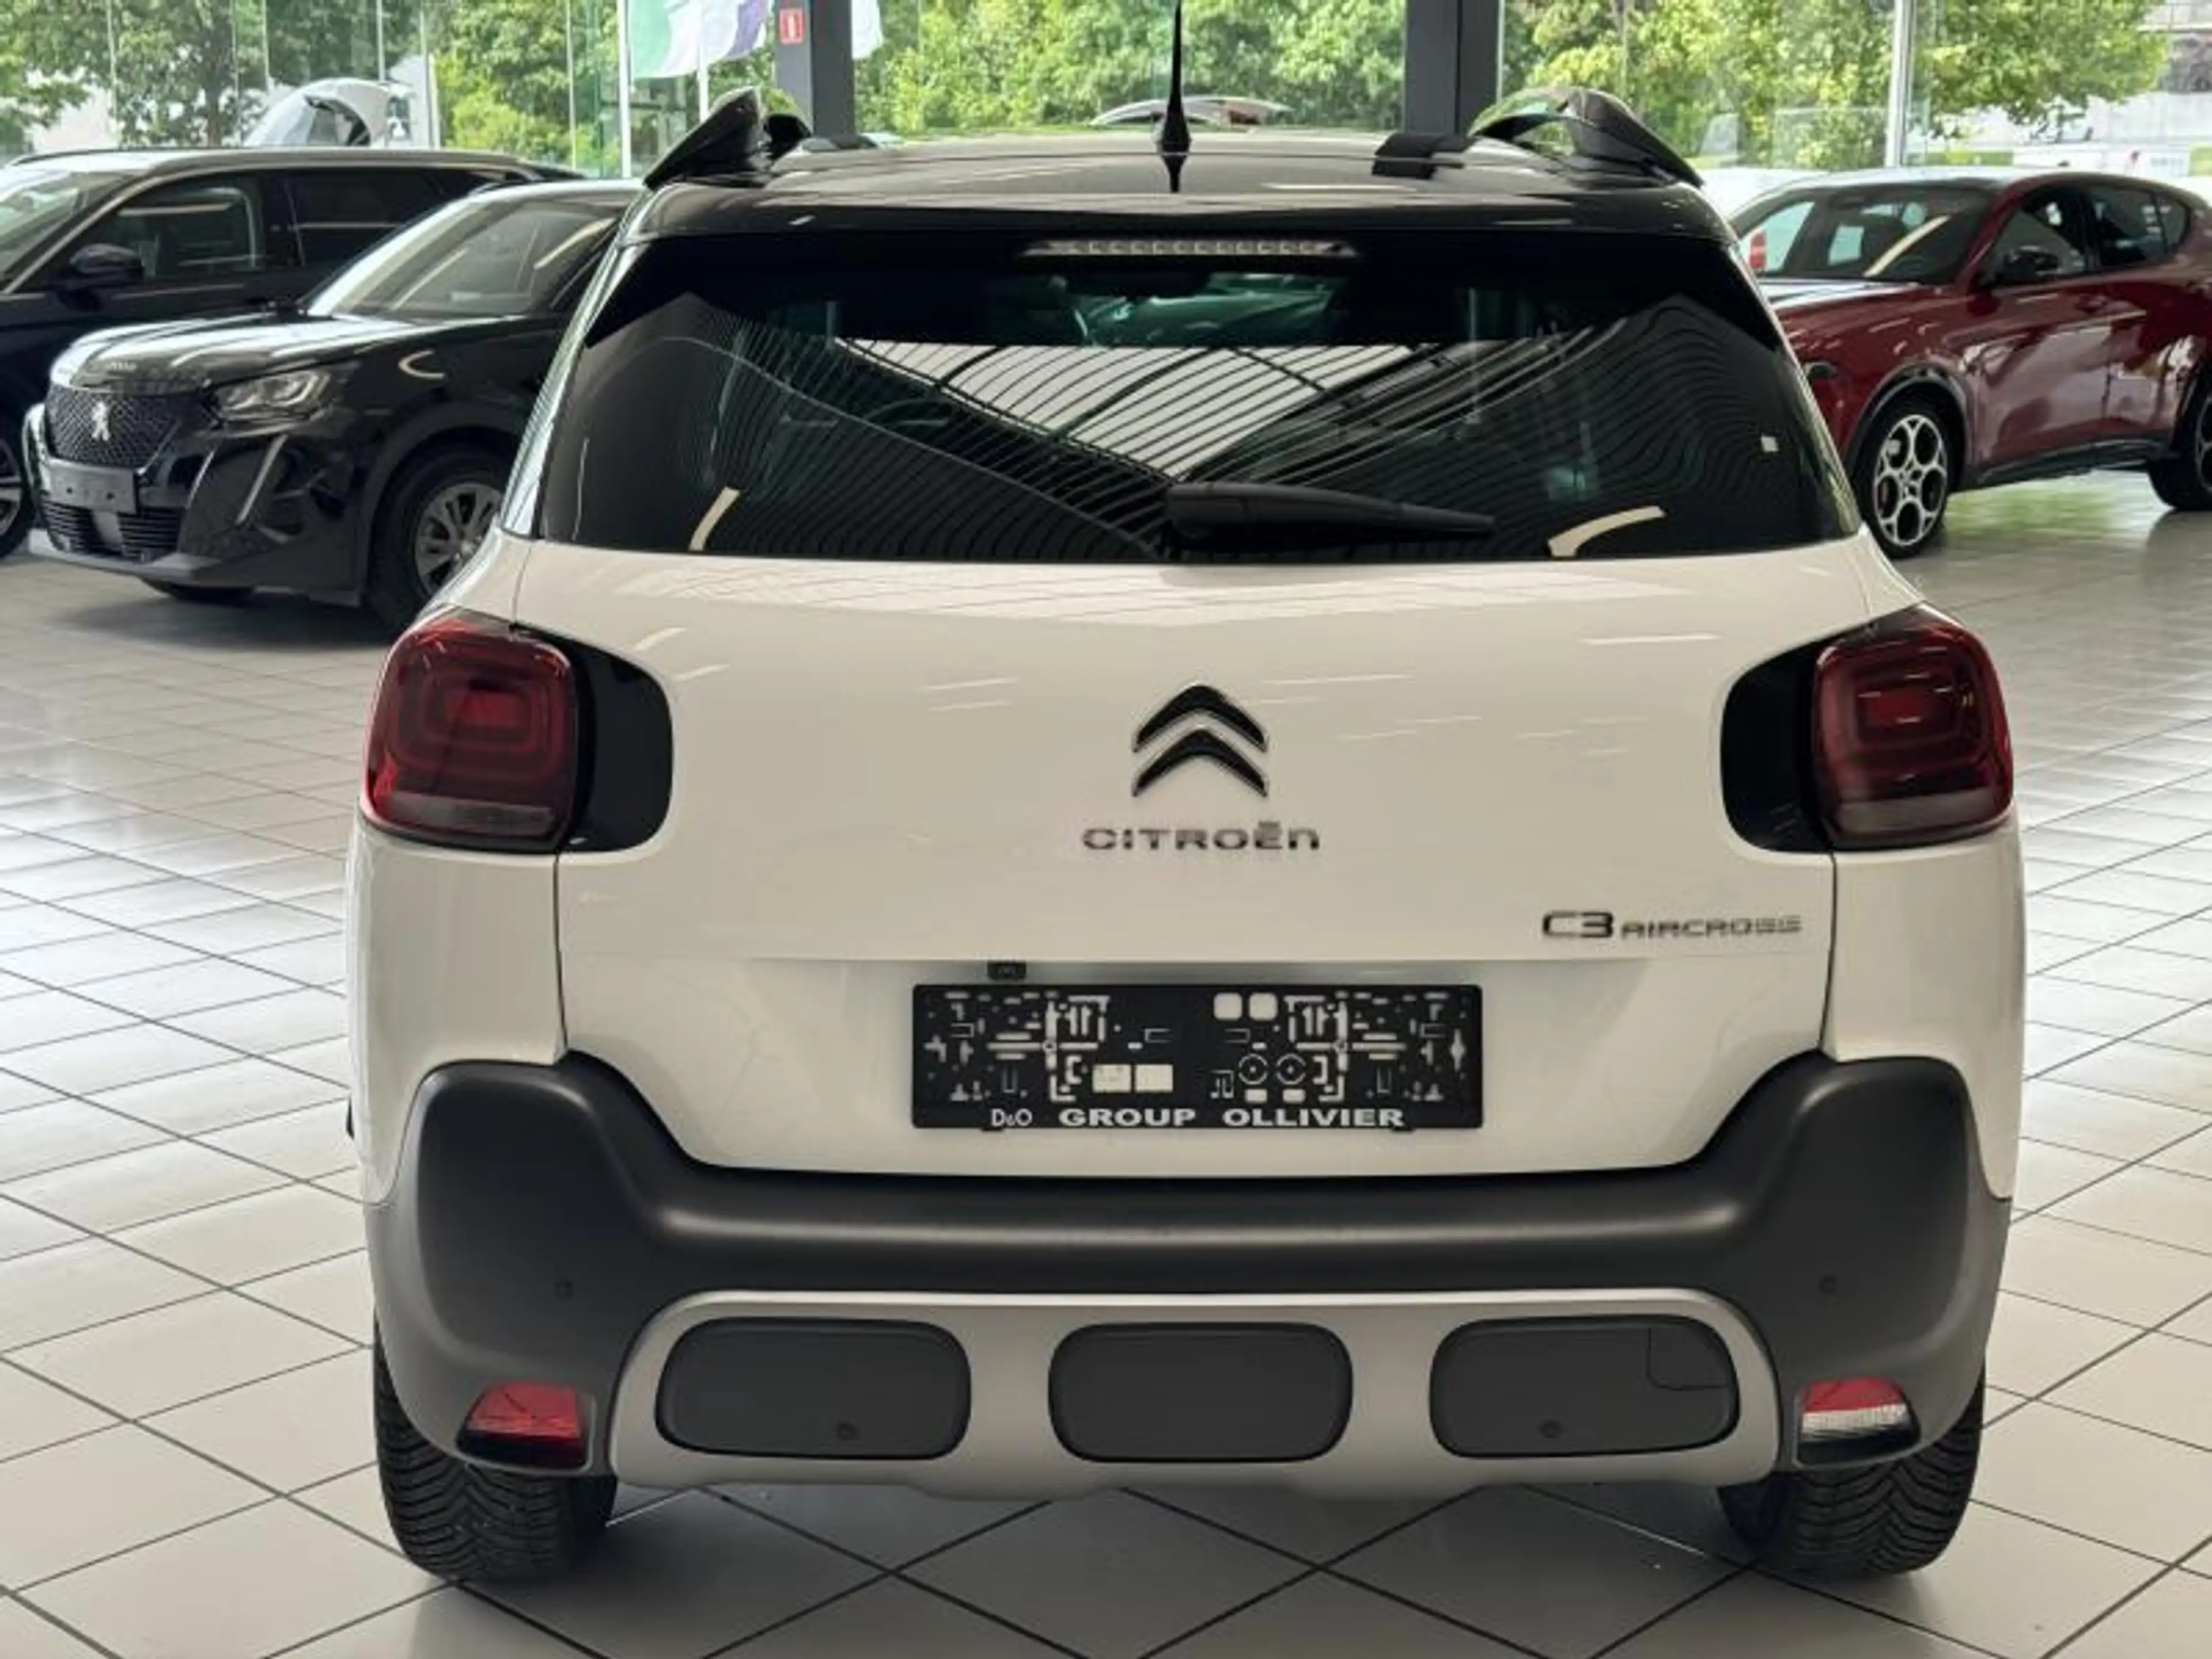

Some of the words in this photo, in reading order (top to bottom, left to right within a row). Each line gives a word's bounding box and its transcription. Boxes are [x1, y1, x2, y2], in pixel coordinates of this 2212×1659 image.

[1541, 910, 1614, 938] C3
[1620, 915, 1803, 939] AIRCROSS
[1058, 1108, 1196, 1127] GROUP
[1222, 1108, 1405, 1127] OLLIVIER
